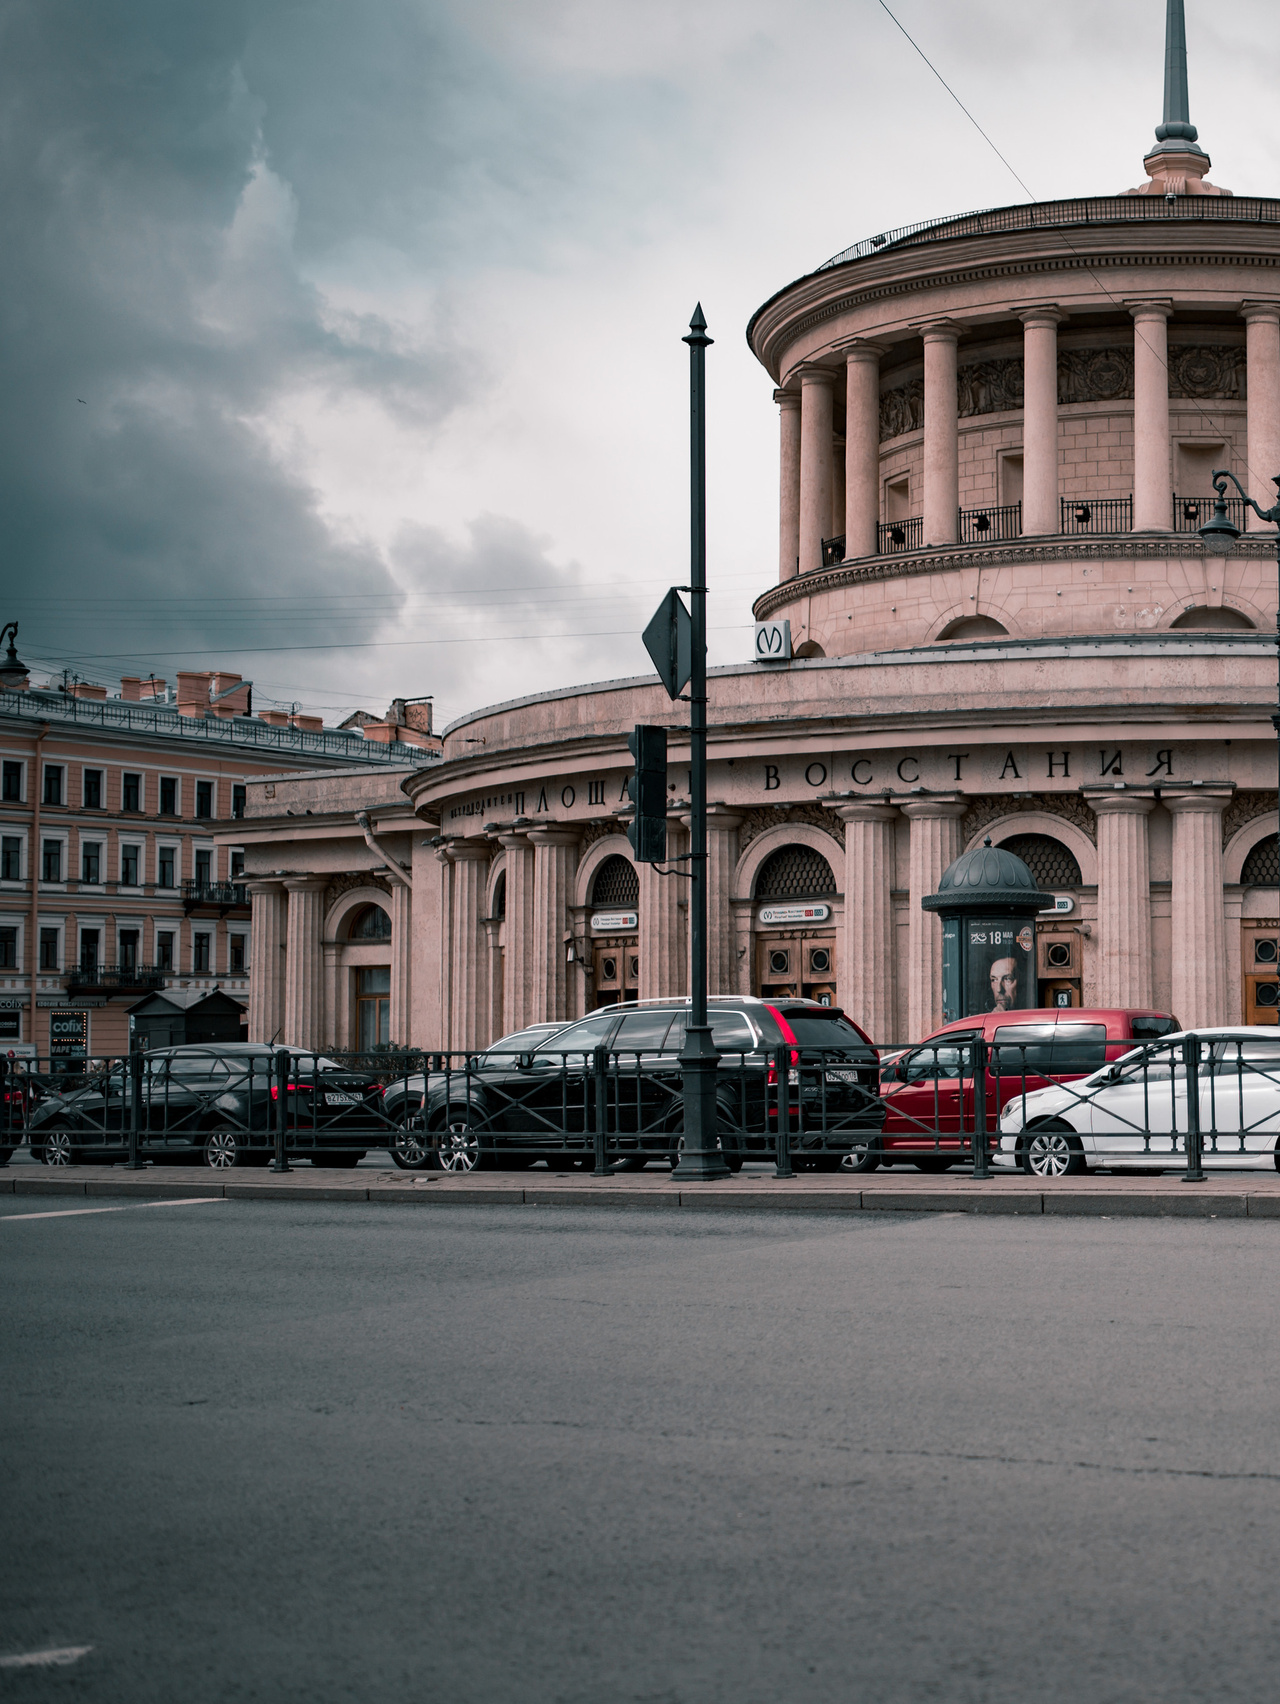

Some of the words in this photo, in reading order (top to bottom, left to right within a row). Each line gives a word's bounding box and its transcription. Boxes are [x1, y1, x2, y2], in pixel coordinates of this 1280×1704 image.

[515, 770, 693, 815] ПЛОЩА
[763, 749, 1175, 791] ВОССТАНИЯ
[1256, 919, 1279, 927] ВХО
[989, 931, 1001, 944] 18
[53, 1020, 83, 1032] cofix
